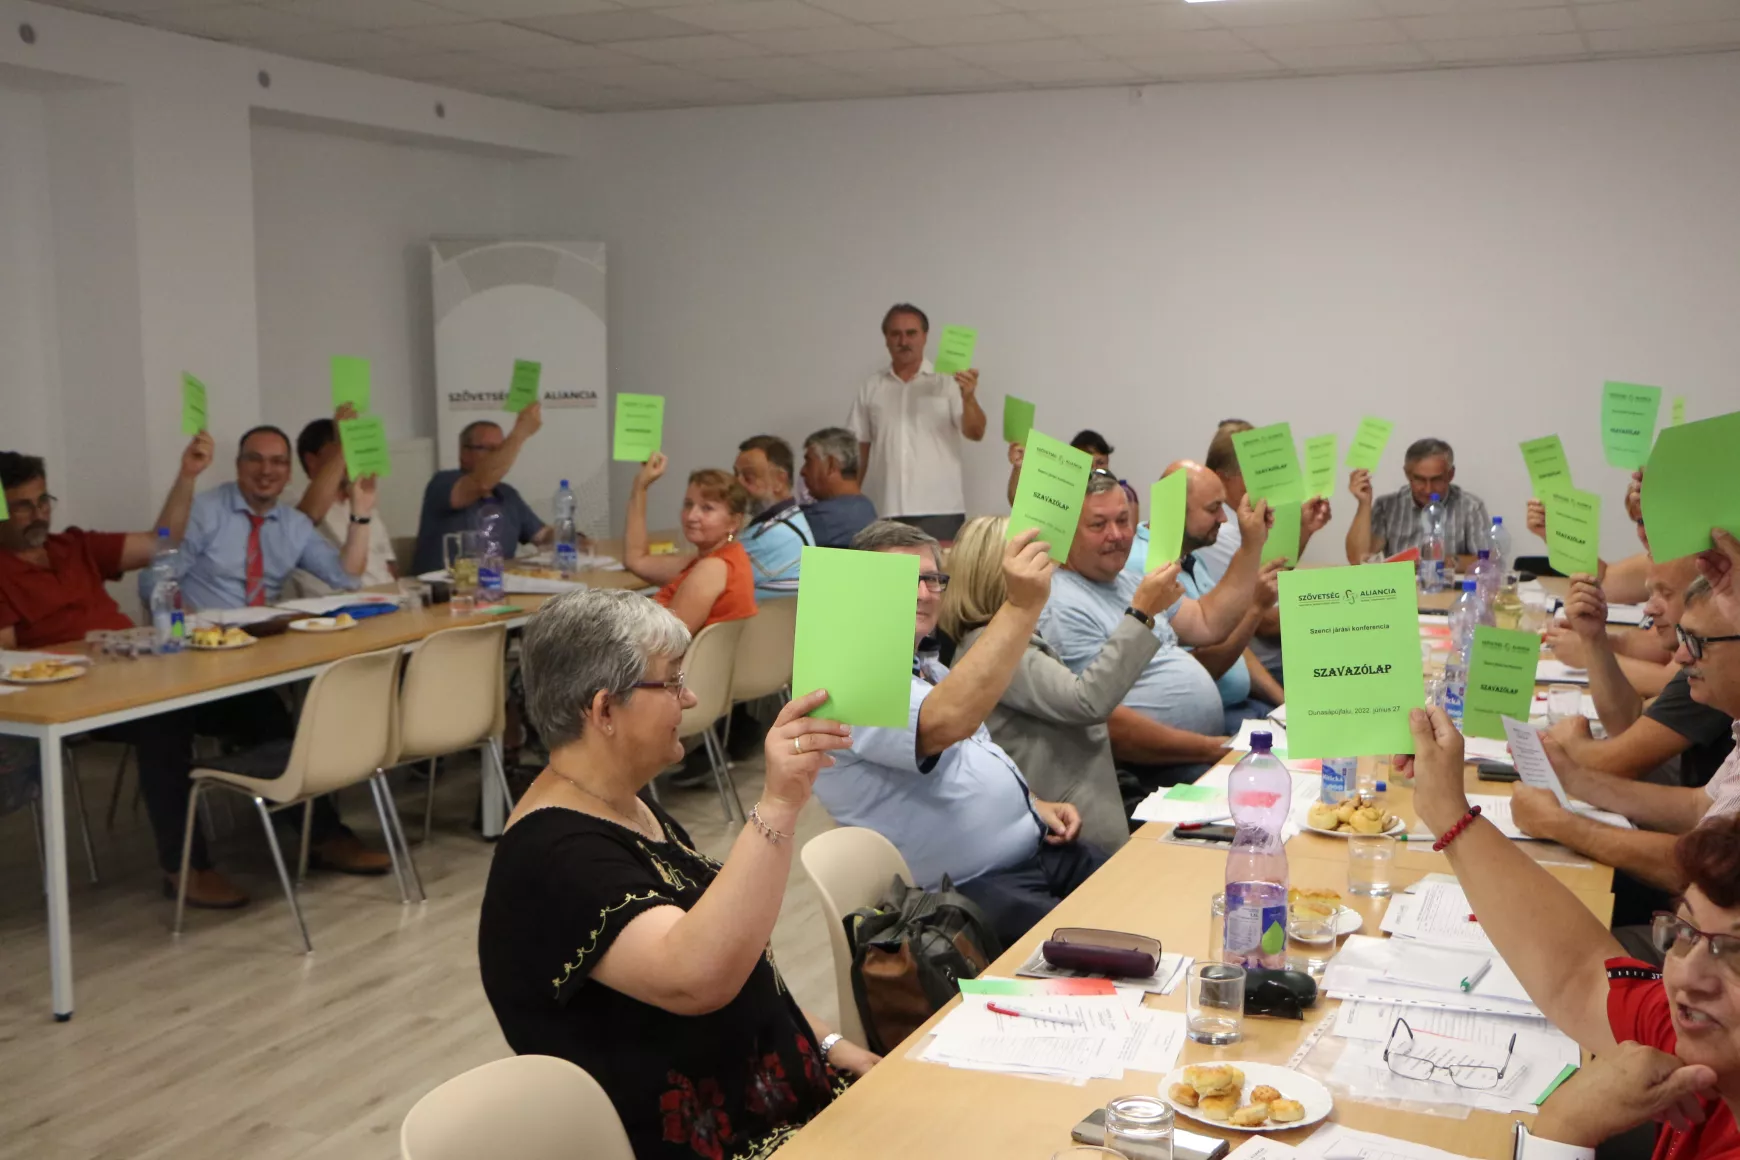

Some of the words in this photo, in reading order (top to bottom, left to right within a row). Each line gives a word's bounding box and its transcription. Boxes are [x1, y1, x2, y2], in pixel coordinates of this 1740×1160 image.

[448, 390, 509, 402] SZÖVETSÉ
[544, 391, 598, 400] ALIANCIA
[1298, 592, 1340, 601] SZÖVETSÉG
[1360, 588, 1397, 597] ALIANCIA
[1332, 626, 1351, 634] járási
[1351, 624, 1390, 632] konferencia
[1313, 664, 1392, 678] SZAVAZÓLAP
